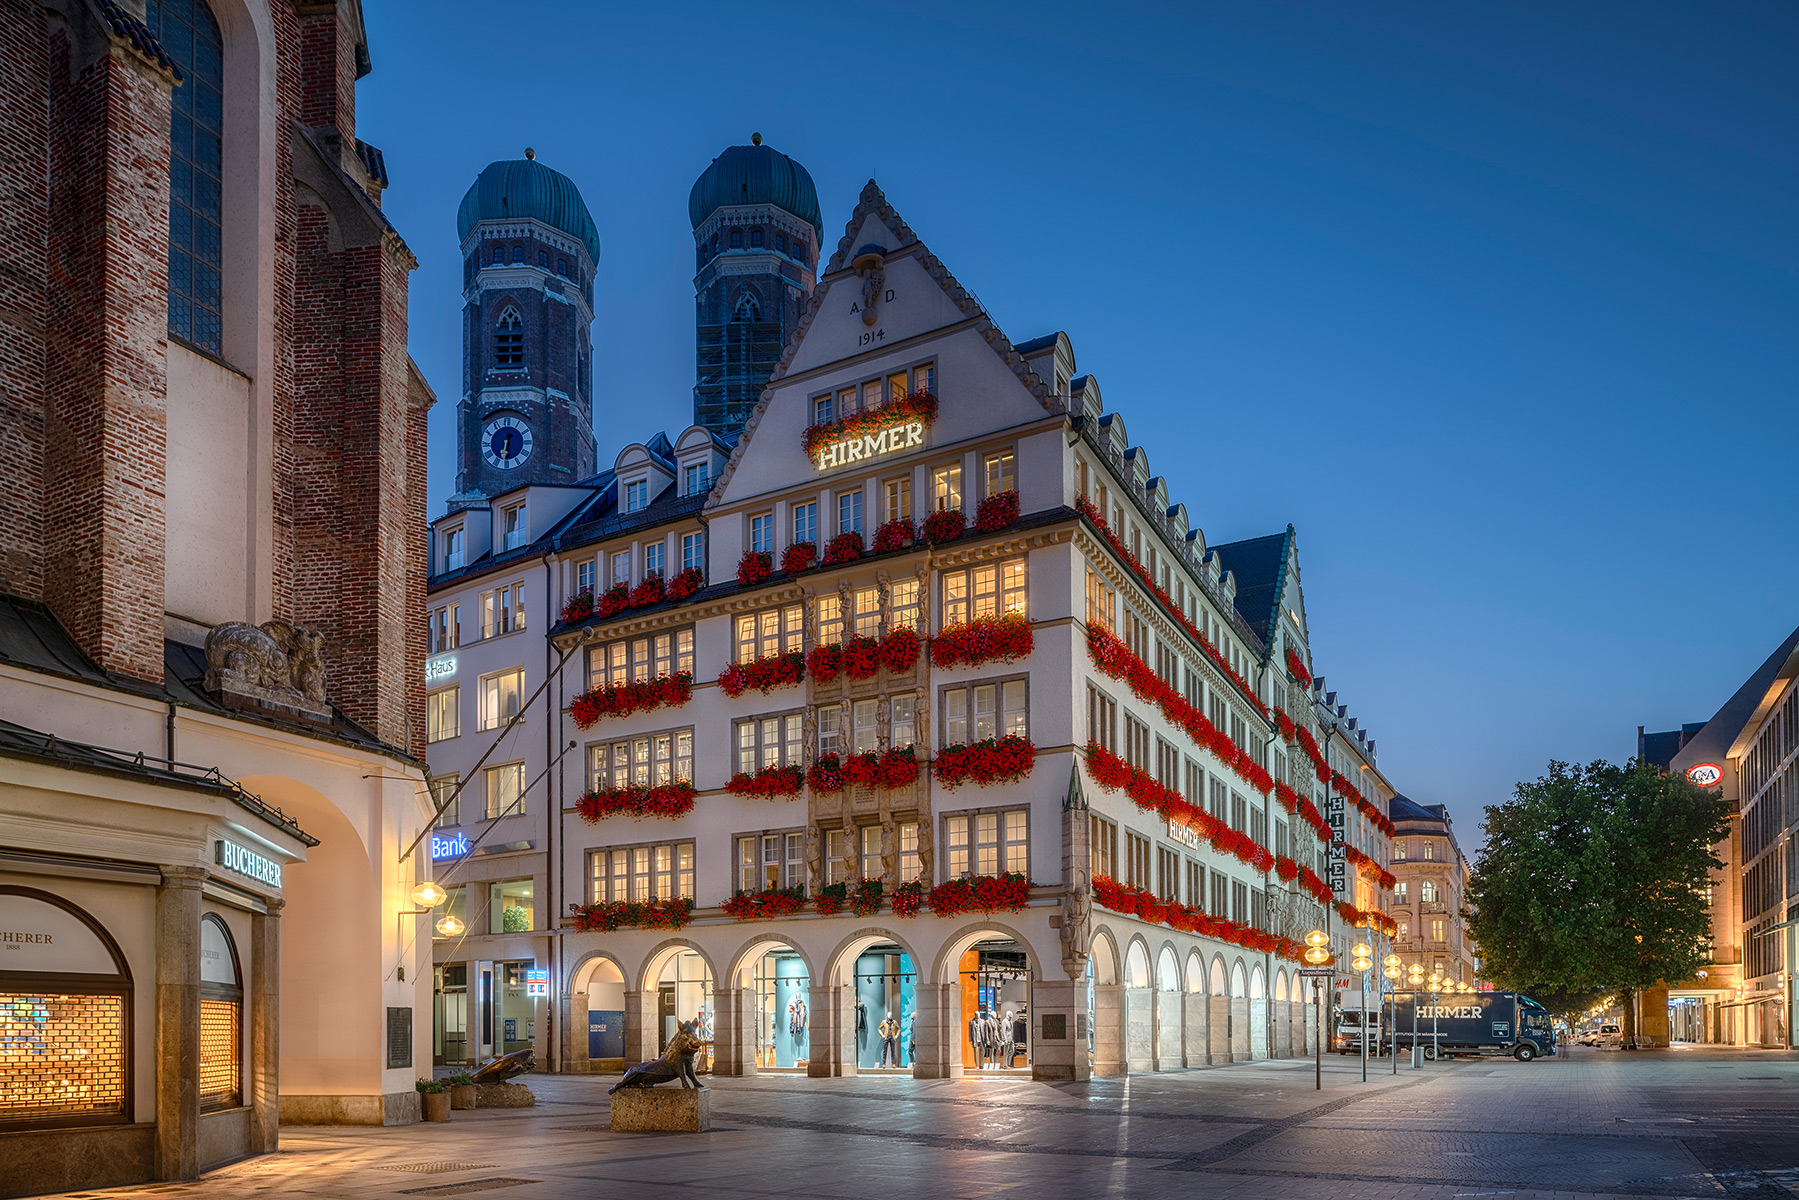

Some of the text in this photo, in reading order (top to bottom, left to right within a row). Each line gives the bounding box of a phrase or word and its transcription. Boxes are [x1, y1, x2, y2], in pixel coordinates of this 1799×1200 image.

[819, 423, 922, 470] HIRMER
[430, 661, 453, 677] Haus
[432, 832, 467, 858] Bank
[1331, 798, 1344, 891] HIRMER
[224, 840, 282, 888] BUCHERER
[0, 931, 53, 944] HERER
[1416, 1006, 1482, 1019] HIRMER
